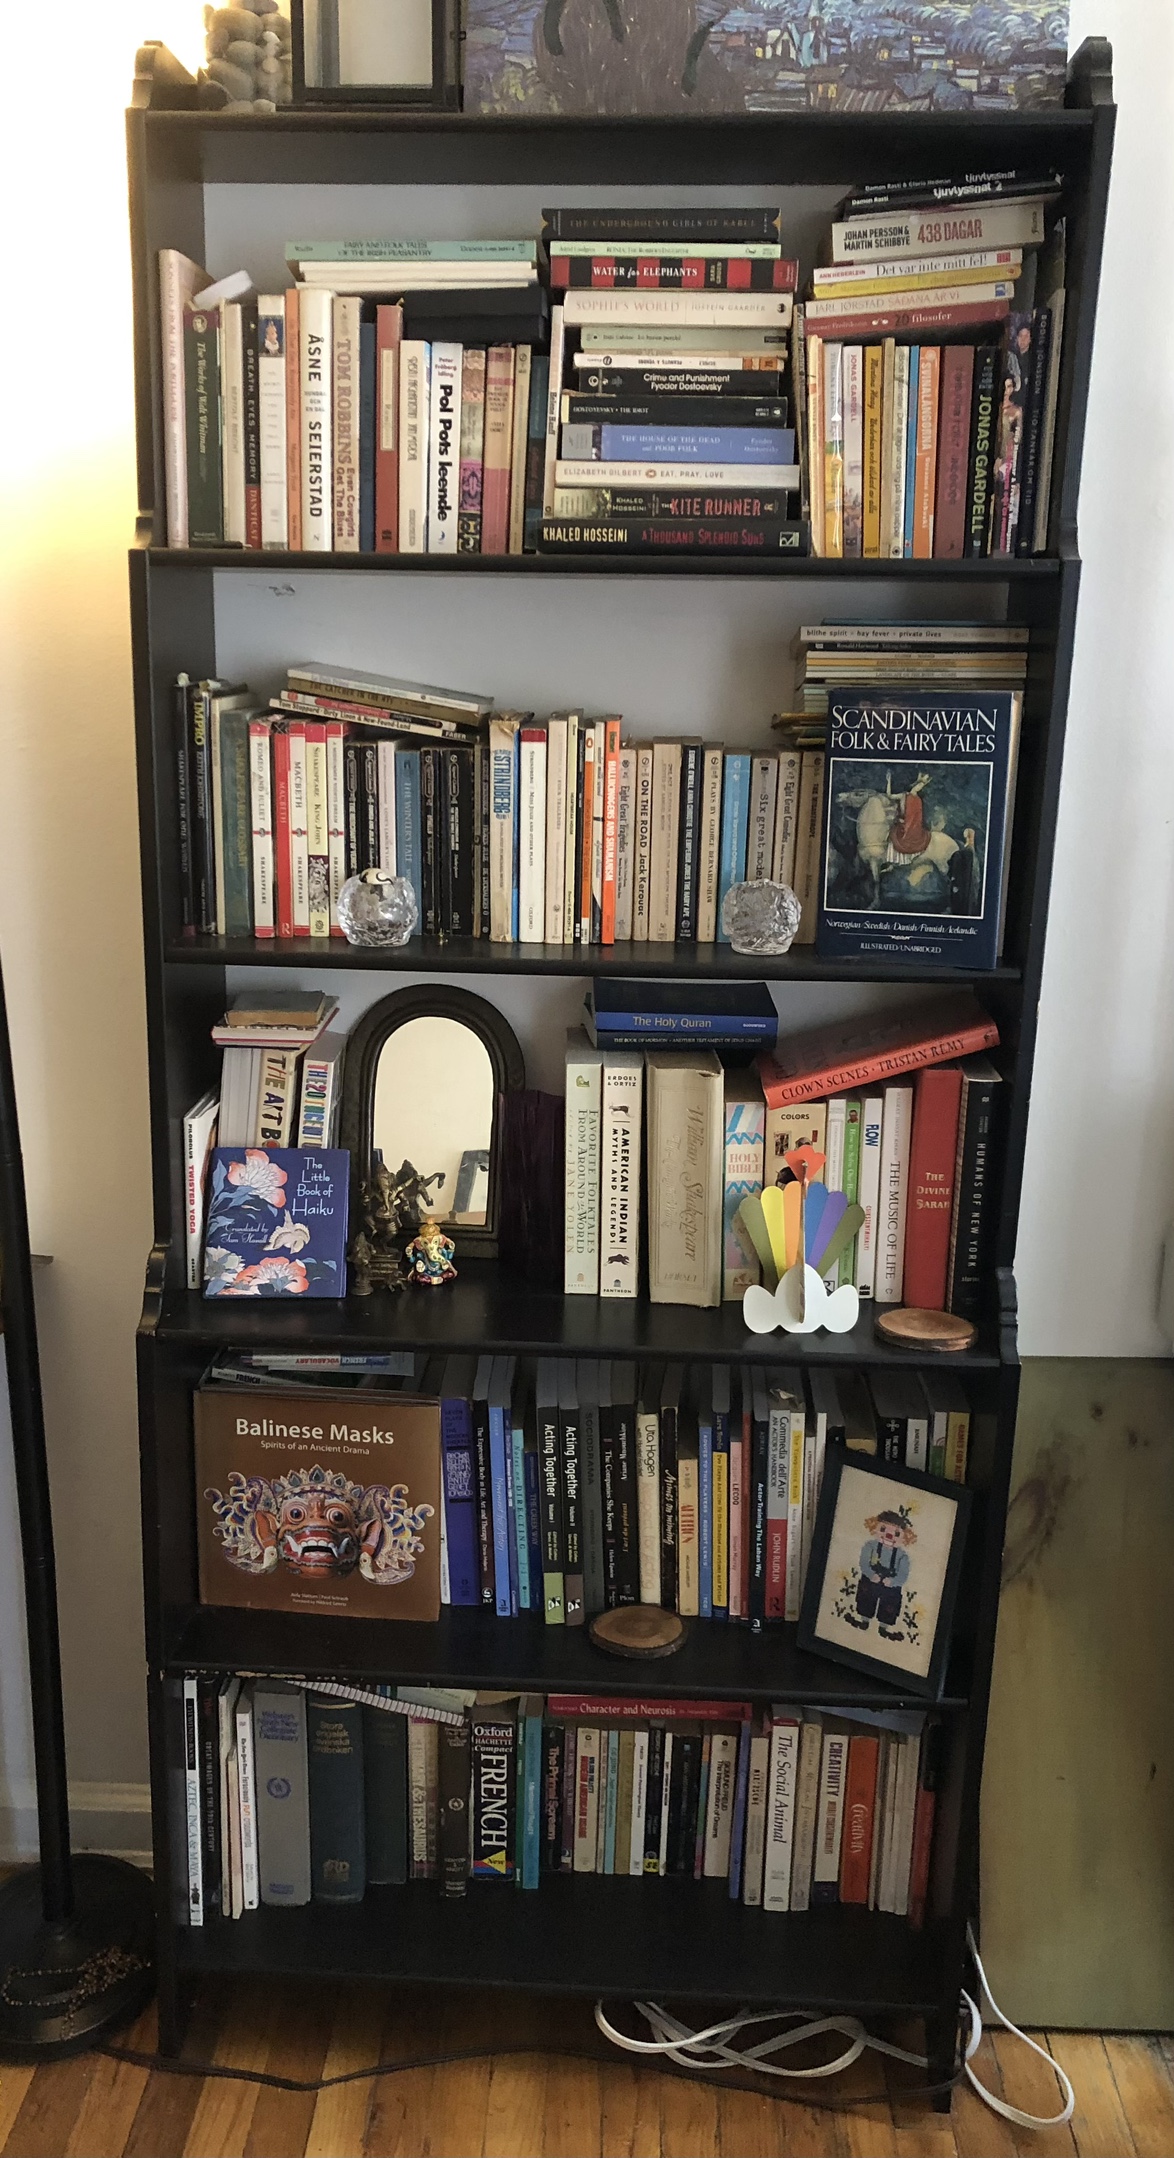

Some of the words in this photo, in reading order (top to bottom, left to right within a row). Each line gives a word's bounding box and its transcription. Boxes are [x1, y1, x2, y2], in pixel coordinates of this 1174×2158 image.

[933, 183, 991, 199] tjuvlyssnat
[995, 181, 1003, 190] 2
[844, 232, 868, 241] JOHAN
[870, 227, 903, 239] PERSSON
[844, 240, 872, 251] MARTIN
[875, 236, 910, 248] SCHIBBYE
[918, 223, 942, 243] 438
[945, 219, 983, 239] DAGAR
[593, 267, 625, 276] WATER
[628, 267, 640, 279] for
[643, 267, 697, 276] ELEPHANTS
[876, 265, 896, 275] Det
[899, 263, 914, 273] var
[916, 260, 940, 272] inte
[943, 257, 967, 269] mitt
[969, 254, 987, 267] fel!
[894, 315, 909, 327] 20
[912, 311, 952, 323] filosofer
[197, 342, 206, 356] The
[309, 335, 324, 381] ÅSNE
[338, 339, 351, 380] TOM
[197, 360, 206, 384] Works
[644, 374, 666, 382] Crime
[686, 374, 730, 383] Punishment
[197, 386, 208, 394] of
[439, 385, 453, 413] Pol
[651, 382, 683, 391] Fyodor
[686, 382, 722, 392] Dostoevsky
[198, 396, 206, 413] Walt
[199, 416, 208, 453] Whitman
[338, 386, 352, 464] ROBBINS
[977, 394, 990, 450] JONAS
[438, 419, 452, 455] Pots
[309, 422, 322, 517] SEIERSTAD
[336, 467, 344, 485] Get
[347, 467, 355, 491] Even
[438, 462, 453, 521] leende
[971, 455, 988, 534] GARDELL
[346, 495, 355, 537] Cowgirls
[672, 499, 701, 515] KITE
[705, 499, 760, 516] RUNNER
[544, 528, 580, 541] KHALED
[584, 528, 628, 541] HOSSEINI
[832, 706, 997, 731] SCANDINAVIAN
[831, 731, 873, 749] FOLK
[877, 733, 890, 750] &
[894, 734, 944, 752] FAIRY
[947, 734, 995, 752] TALES
[494, 756, 511, 813] STRINDBERG
[606, 761, 616, 819] HALLUCINOGENS
[641, 780, 649, 795] ON
[607, 821, 616, 836] AND
[640, 820, 648, 847] ROAD
[605, 838, 615, 881] SHAMANISM
[638, 877, 647, 916] Kerouac
[633, 1016, 651, 1027] The
[655, 1017, 678, 1030] Holy
[681, 1018, 711, 1029] Quran
[265, 1054, 287, 1089] THE
[781, 1082, 824, 1101] CLOWN
[826, 1071, 870, 1091] SCENES
[877, 1050, 928, 1073] TRISTAN
[930, 1037, 966, 1059] REMY
[263, 1092, 286, 1123] ART
[578, 1109, 587, 1143] FROM
[685, 1105, 704, 1166] William
[865, 1124, 879, 1146] FLOW
[588, 1110, 599, 1174] FAVORITE
[304, 1157, 323, 1169] The
[620, 1128, 630, 1193] AMERICAN
[727, 1164, 762, 1173] BIBLE
[728, 1154, 758, 1162] HOLY
[974, 1143, 986, 1187] HUMANS
[301, 1170, 330, 1183] Little
[577, 1146, 587, 1199] AROUND
[889, 1161, 900, 1187] THE
[925, 1172, 945, 1181] THE
[297, 1184, 321, 1197] Book
[323, 1183, 334, 1197] of
[972, 1193, 982, 1206] OF
[292, 1199, 334, 1216] Haiku
[587, 1181, 597, 1254] FOLKTALES
[619, 1198, 628, 1243] INDIAN
[679, 1172, 703, 1262] Shakespeare
[887, 1190, 899, 1230] MUSIC
[576, 1211, 586, 1254] WORLD
[970, 1212, 981, 1234] NEW
[886, 1234, 897, 1251] OF
[967, 1241, 978, 1268] YORK
[885, 1254, 896, 1279] LIFE
[236, 1418, 323, 1439] Balinese
[330, 1424, 394, 1444] Masks
[544, 1424, 556, 1455] Acting
[564, 1426, 577, 1457] Acting
[645, 1424, 656, 1442] Uta
[778, 1417, 789, 1459] Commedia
[261, 1441, 286, 1451] Spirits
[288, 1442, 295, 1450] of
[310, 1444, 341, 1453] Ancient
[343, 1446, 370, 1455] Drama
[644, 1445, 656, 1478] Hagen
[544, 1457, 556, 1497] Together
[566, 1458, 577, 1499] Together
[777, 1463, 787, 1498] dell'Arte
[756, 1483, 764, 1502] Actor
[755, 1503, 764, 1528] Training
[772, 1533, 781, 1553] JOHN
[772, 1556, 780, 1583] RUDLIN
[580, 1703, 614, 1713] Character
[617, 1706, 634, 1714] and
[636, 1706, 676, 1714] Neurosis
[474, 1726, 513, 1736] Oxford
[548, 1747, 560, 1765] The
[777, 1735, 793, 1757] The
[548, 1766, 559, 1799] Primal
[775, 1760, 791, 1796] Social
[827, 1742, 843, 1797] CREATIVITY
[186, 1778, 199, 1812] AZTEC,
[480, 1754, 508, 1847] FRENCH
[188, 1815, 199, 1838] INCA
[547, 1801, 558, 1840] Scream
[772, 1799, 788, 1844] Animal
[188, 1840, 198, 1849] &
[189, 1852, 199, 1877] MAYA
